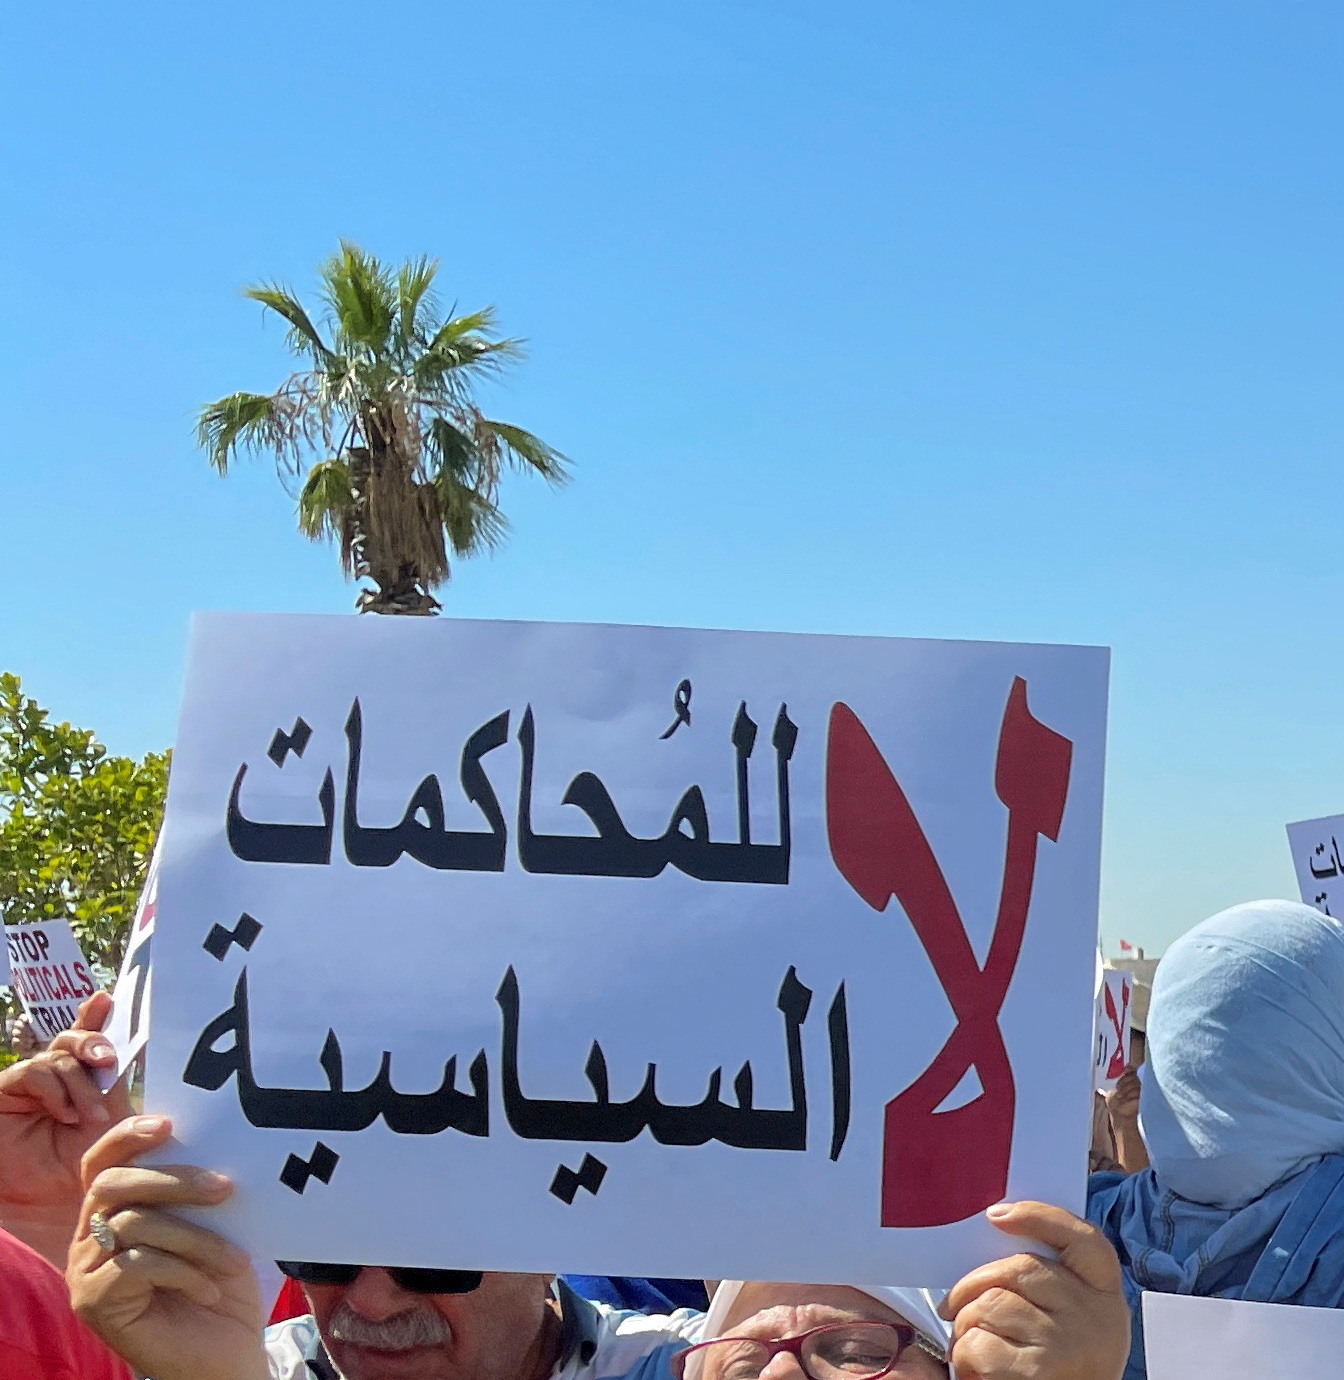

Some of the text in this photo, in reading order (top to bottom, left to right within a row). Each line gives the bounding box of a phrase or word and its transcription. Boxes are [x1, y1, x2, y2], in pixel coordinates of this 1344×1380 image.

[6, 930, 49, 962] STOP
[29, 1004, 76, 1037] TRIA
[825, 675, 1073, 1229] لا
[182, 912, 849, 1205] السياسية
